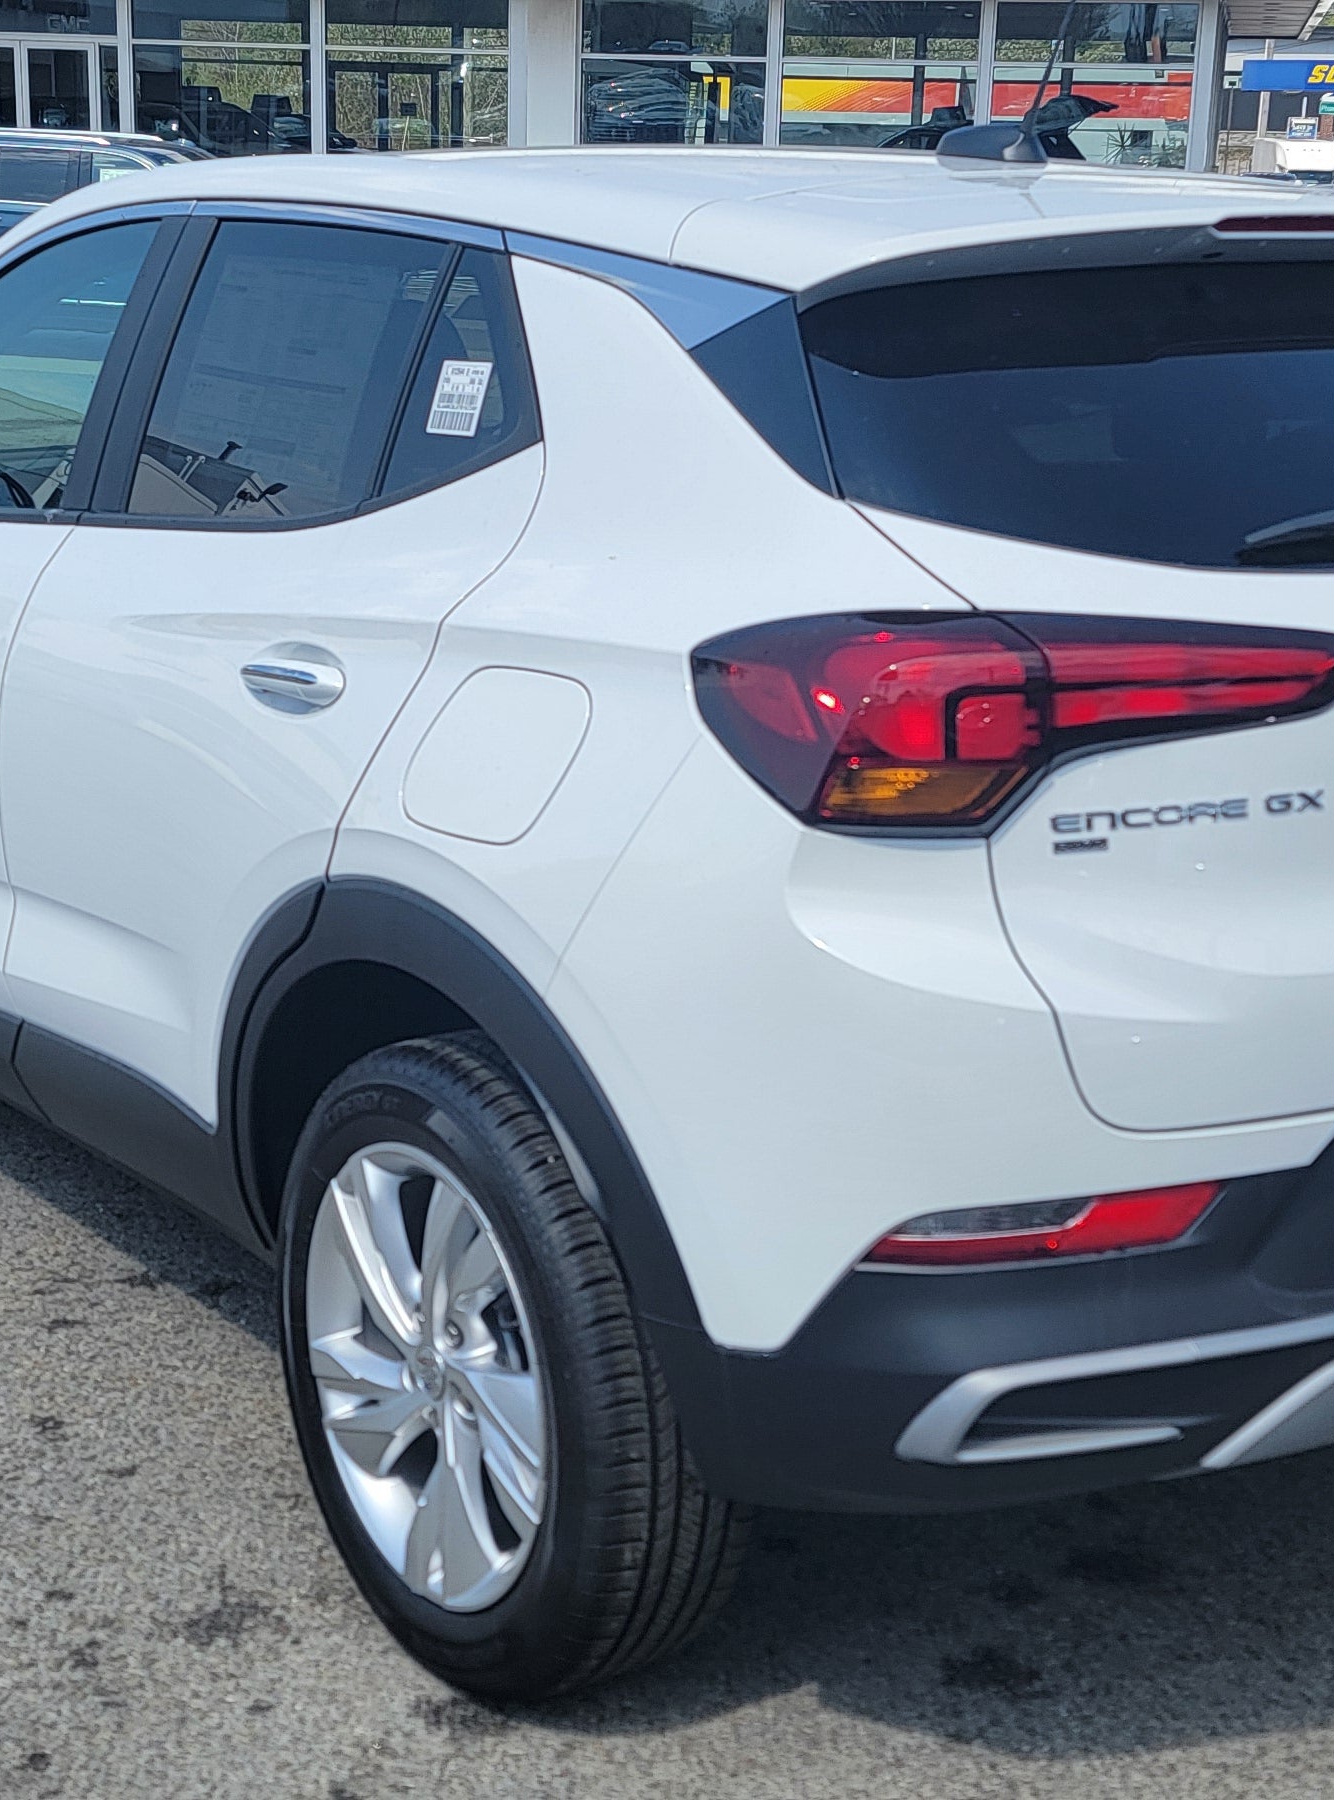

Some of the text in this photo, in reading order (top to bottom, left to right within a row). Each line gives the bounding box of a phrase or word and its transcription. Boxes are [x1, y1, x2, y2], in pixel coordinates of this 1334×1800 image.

[47, 14, 90, 33] GMC
[1051, 789, 1324, 833] ENCORE GX
